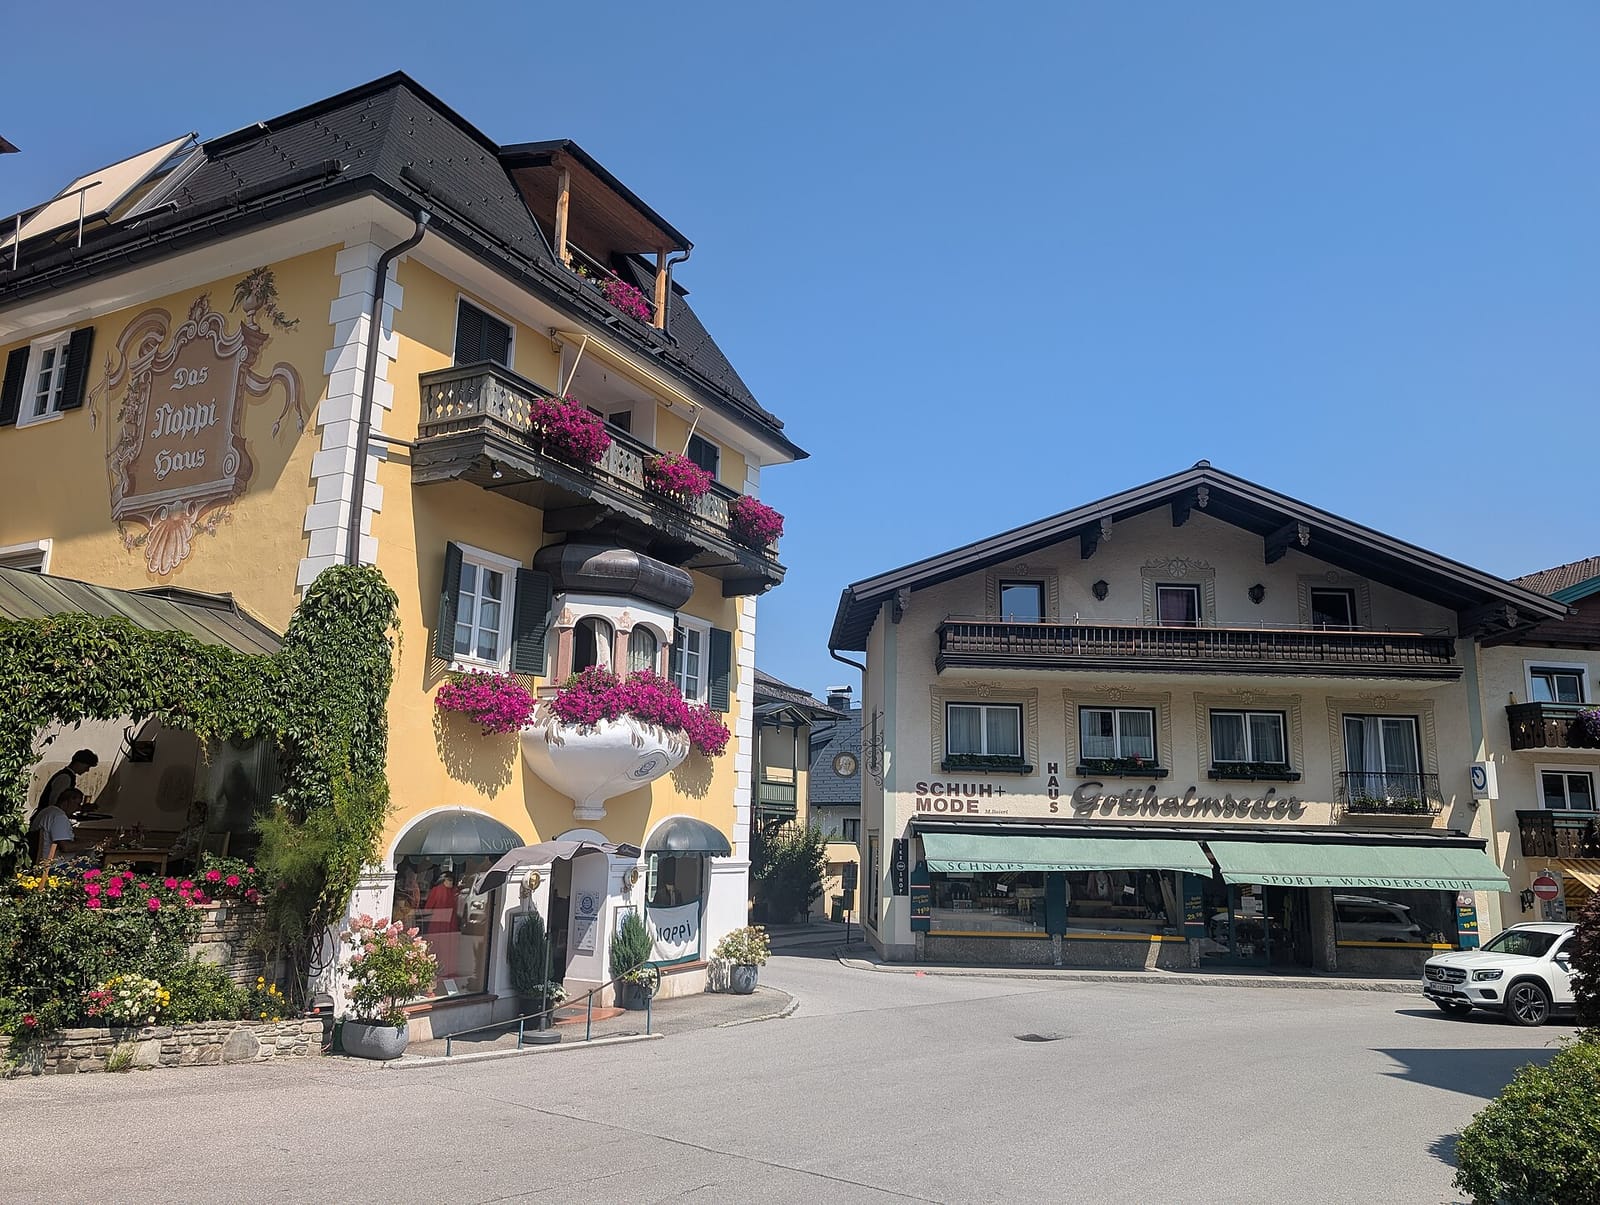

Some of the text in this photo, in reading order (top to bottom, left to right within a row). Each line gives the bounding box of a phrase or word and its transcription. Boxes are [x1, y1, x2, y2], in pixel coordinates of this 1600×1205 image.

[170, 366, 209, 391] Das
[151, 398, 219, 442] Noppi
[154, 448, 206, 481] Haus
[1047, 762, 1060, 814] HAUS
[915, 798, 980, 813] MODE
[947, 861, 1025, 871] SCHNAPS
[1261, 875, 1314, 885] SPORT
[1340, 878, 1473, 890] WANDERSCHUH
